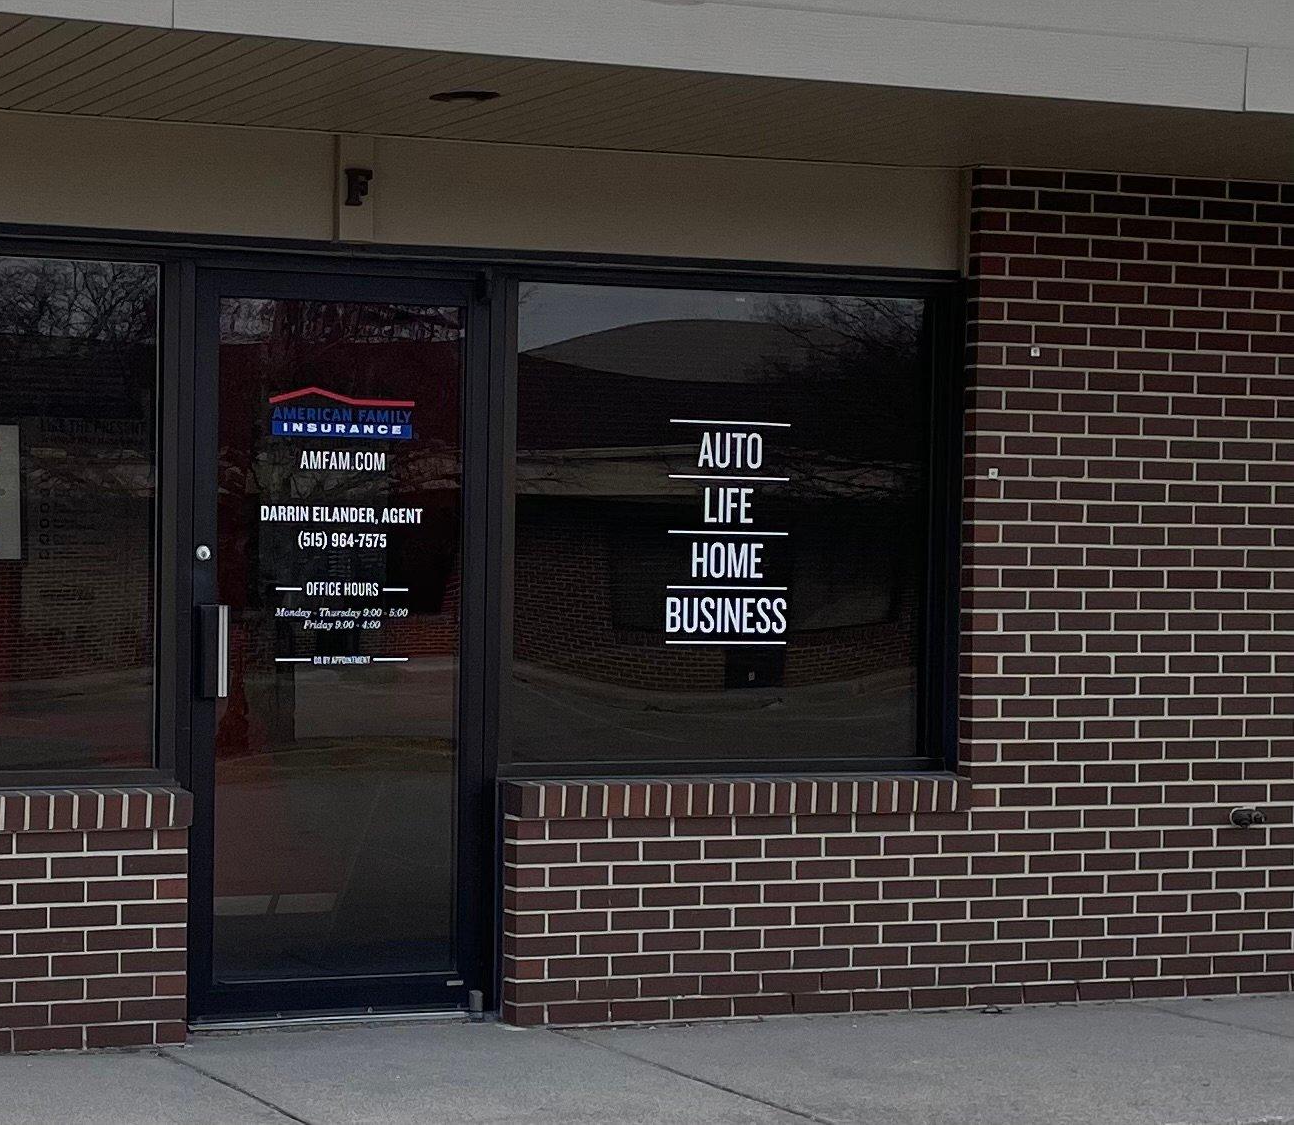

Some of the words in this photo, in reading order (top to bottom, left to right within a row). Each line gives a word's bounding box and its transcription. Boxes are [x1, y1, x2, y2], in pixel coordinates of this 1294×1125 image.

[273, 407, 352, 421] AMERICAN
[359, 409, 412, 423] FAMILY
[283, 423, 402, 435] INSURANCE
[697, 432, 763, 469] AUTO
[300, 450, 386, 471] AMFAM.COM
[260, 505, 308, 522] DARRIN
[312, 506, 379, 524] EILANDER,
[381, 508, 423, 524] AGENT
[704, 487, 754, 524] LIFE
[297, 531, 328, 549] (515)
[331, 532, 387, 548] 964-7575
[691, 542, 764, 579] HOME
[306, 581, 341, 596] OFFICE
[344, 582, 379, 597] HOURS
[274, 607, 312, 618] Monday
[319, 607, 361, 619] Thursday
[362, 608, 382, 617] 9:00
[389, 608, 408, 617] 5:00
[665, 596, 787, 634] BUSINESS
[303, 620, 333, 631] Friday
[335, 620, 355, 629] 9:00
[361, 620, 381, 629] 4:00
